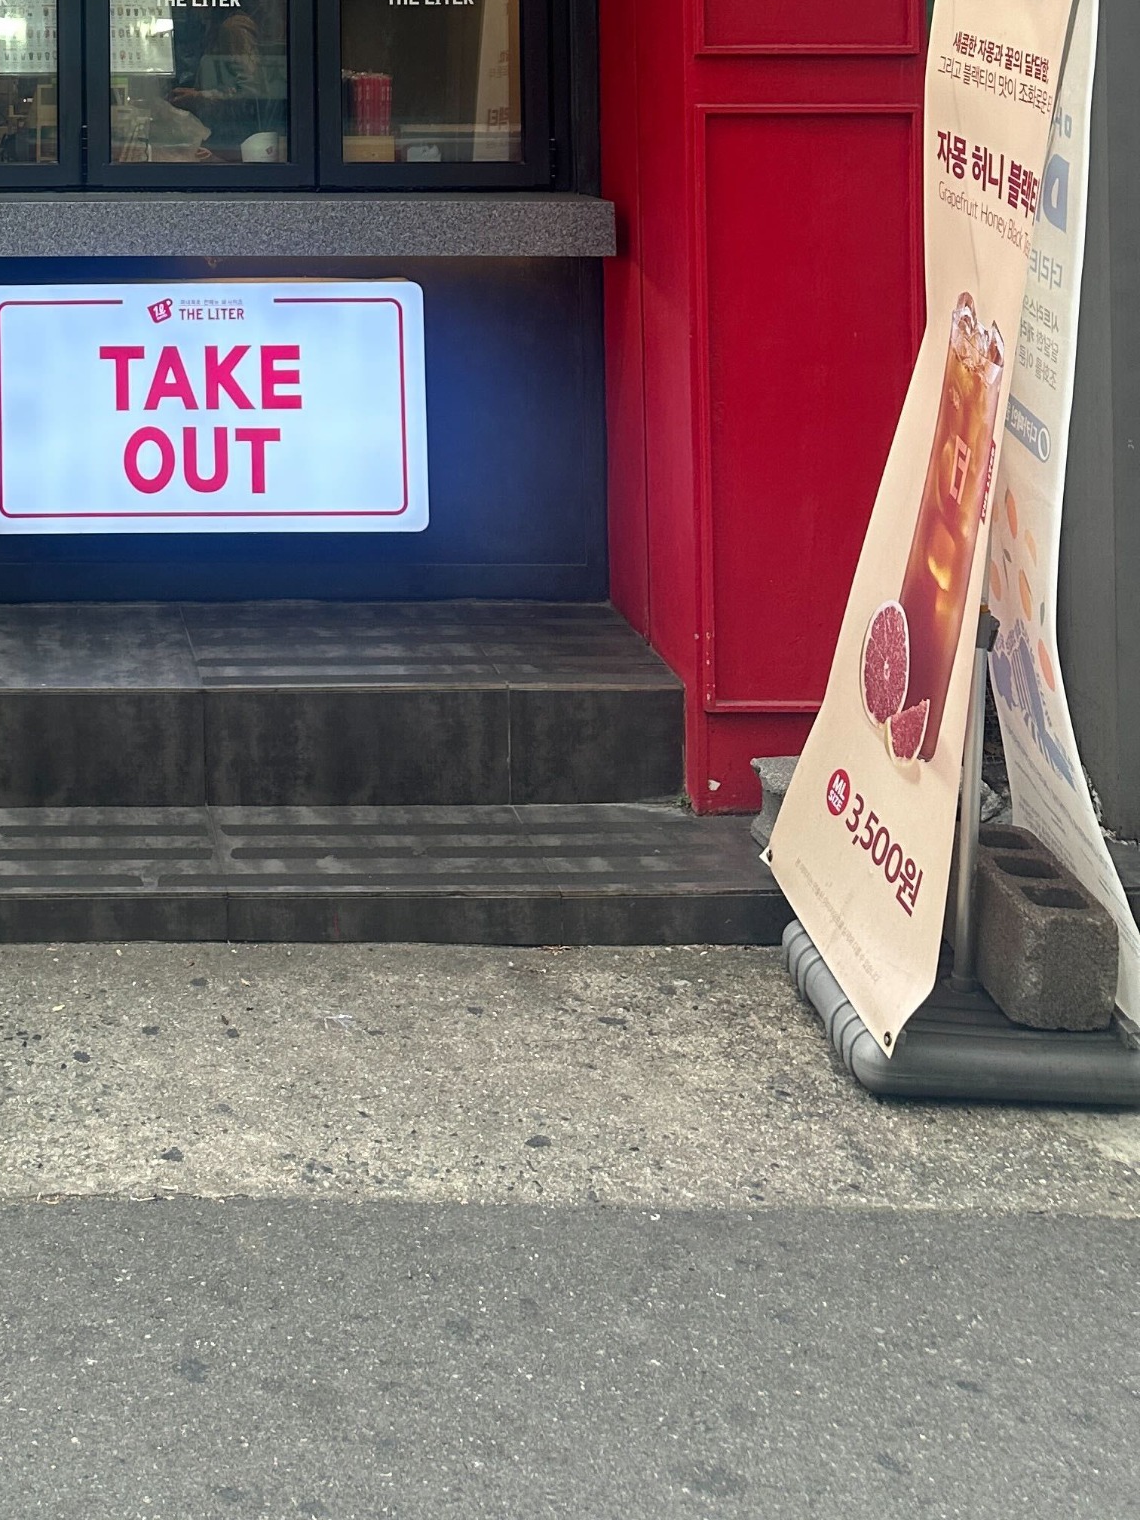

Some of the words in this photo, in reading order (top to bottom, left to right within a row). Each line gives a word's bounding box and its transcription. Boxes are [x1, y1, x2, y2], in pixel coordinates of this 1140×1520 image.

[938, 56, 962, 79] 그리고
[963, 62, 997, 94] 블랙티의
[998, 75, 1017, 101] 맛이
[952, 31, 978, 58] 새콤한
[977, 39, 1004, 67] 자몽과
[1005, 46, 1024, 73] 꿀의
[936, 130, 967, 180] 자몽
[972, 145, 1004, 199] 허니
[1007, 160, 1041, 226] 블랙티
[938, 180, 978, 220] Grapefruit
[980, 202, 1007, 238] Honey
[1007, 218, 1024, 250] Black
[179, 308, 203, 320] THE
[208, 308, 244, 320] LITER
[99, 345, 302, 411] TAKE
[123, 426, 281, 495] OUT
[828, 790, 843, 812] SIZE
[833, 774, 847, 800] ML
[845, 793, 923, 918] 3,500원
